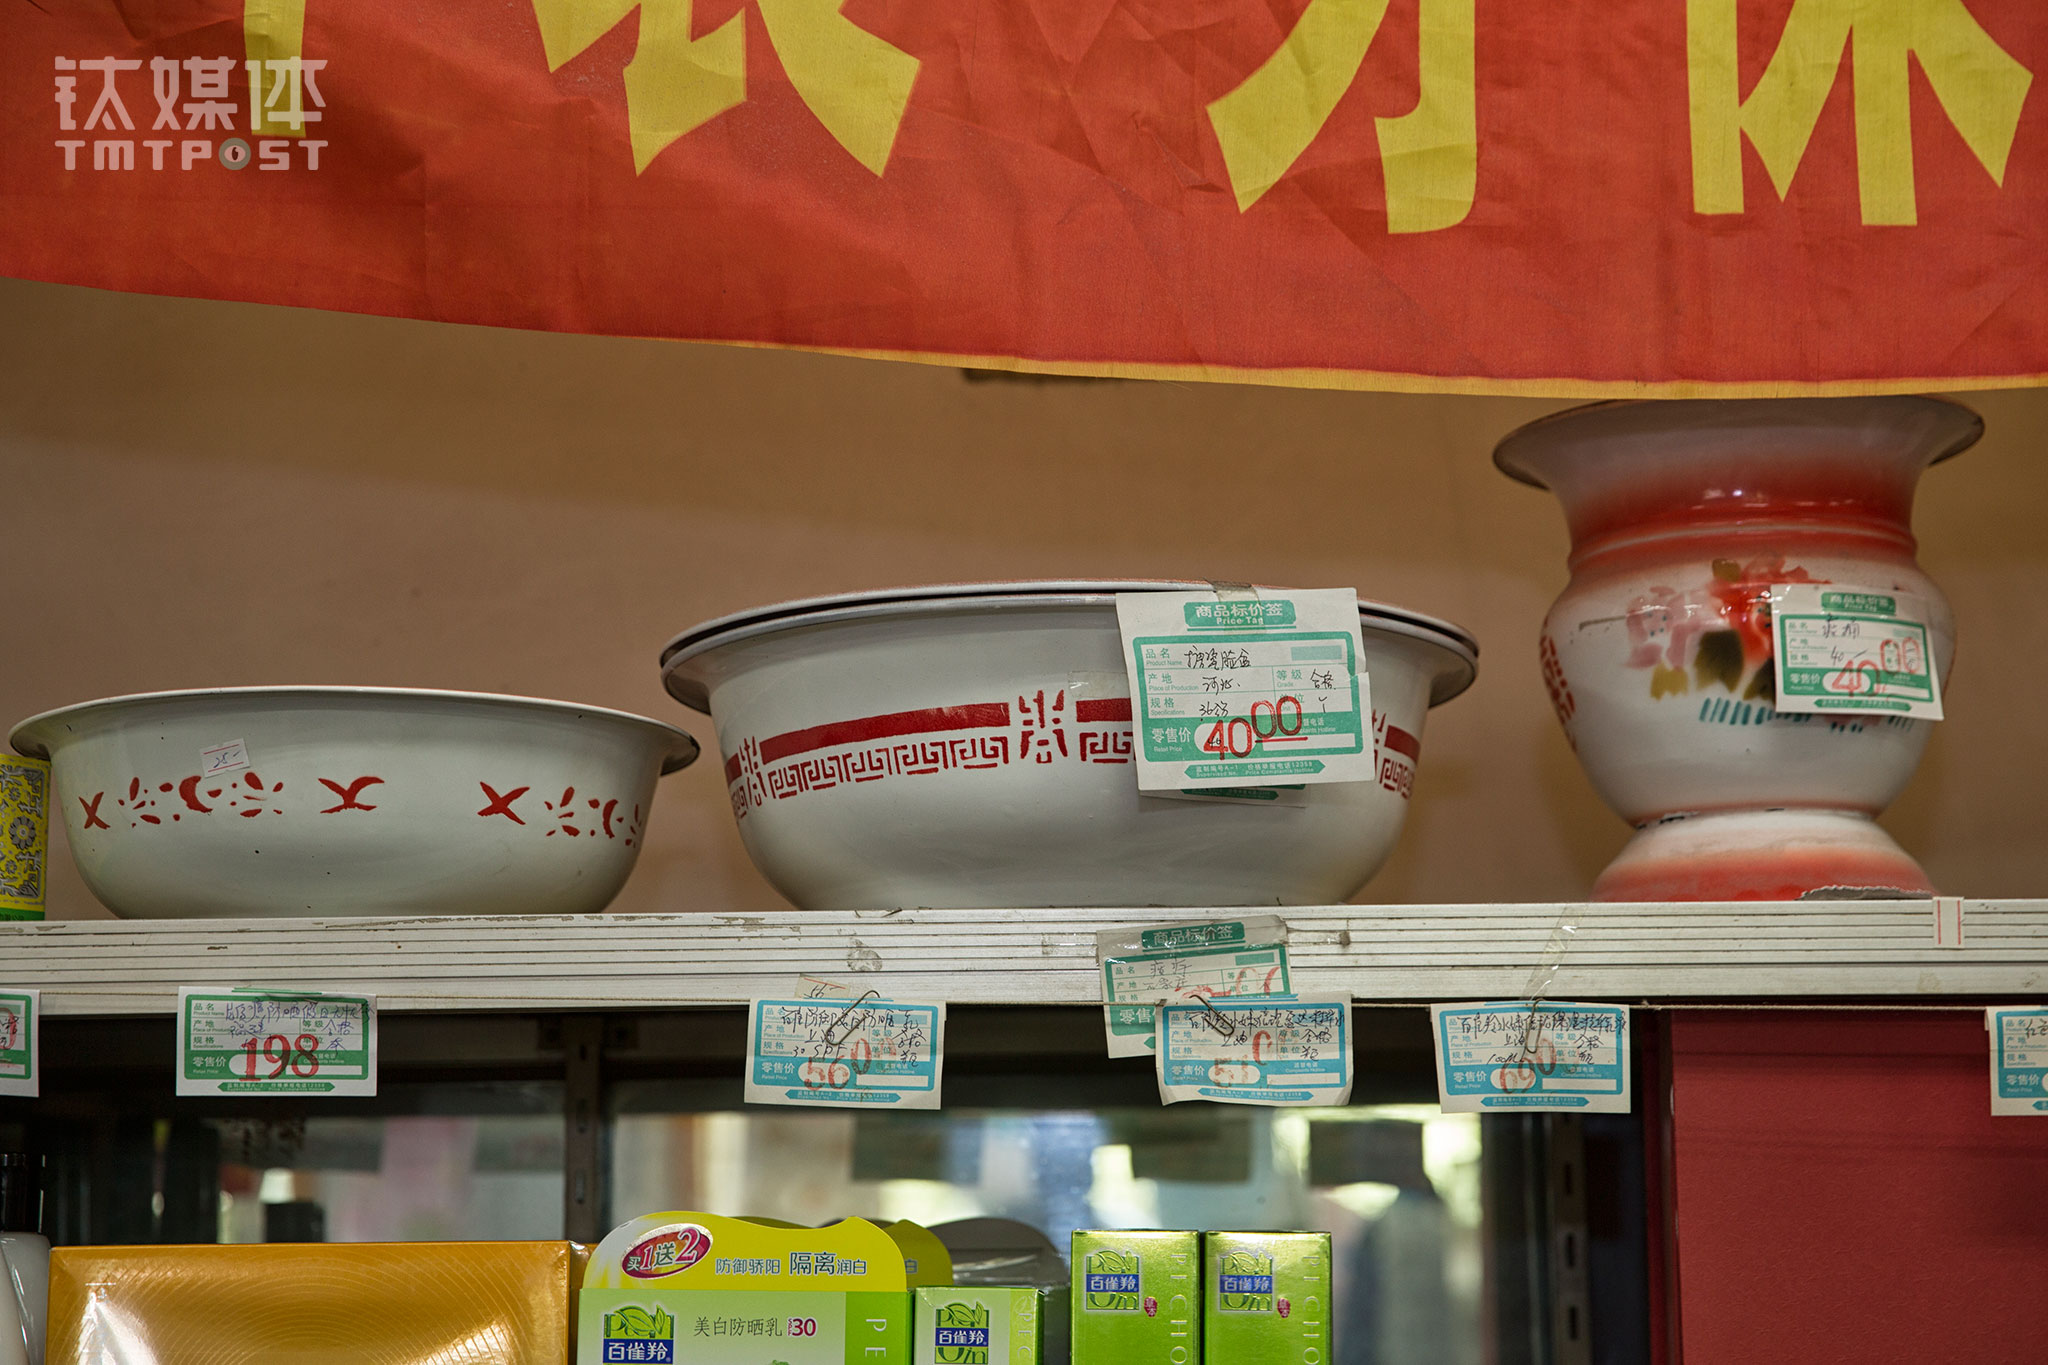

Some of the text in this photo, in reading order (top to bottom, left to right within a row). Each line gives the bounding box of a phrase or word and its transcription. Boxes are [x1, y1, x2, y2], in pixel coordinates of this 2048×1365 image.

[1195, 603, 1283, 618] 商品标价签
[1217, 616, 1264, 625] Price Tag
[1146, 647, 1170, 659] 品名
[1148, 673, 1172, 684] 产地
[1276, 669, 1303, 680] 等级
[1151, 697, 1175, 708] 规格
[1152, 727, 1191, 743] 零售价
[1153, 925, 1233, 945] 商品标价签
[1115, 966, 1135, 975] 品名
[1116, 981, 1137, 989] 产地
[193, 1003, 215, 1011] 品名
[1119, 1009, 1155, 1025] 零售
[193, 1020, 214, 1028] 产地
[193, 1036, 214, 1044] 规格
[192, 1056, 227, 1068] 零售价
[239, 1034, 319, 1081] 198
[761, 1062, 796, 1074] 零售价
[1171, 1065, 1206, 1076] 零售价
[1453, 1070, 1487, 1082] 零售价
[626, 1227, 700, 1272] 买1送2
[715, 1251, 867, 1275] 防御骄阳 隔离润白
[1090, 1276, 1136, 1291] 百雀羚
[1224, 1277, 1270, 1292] 百雀羚
[693, 1316, 782, 1337] 美白防晒乳
[939, 1330, 985, 1345] 百雀羚
[608, 1342, 668, 1361] 百雀羚
